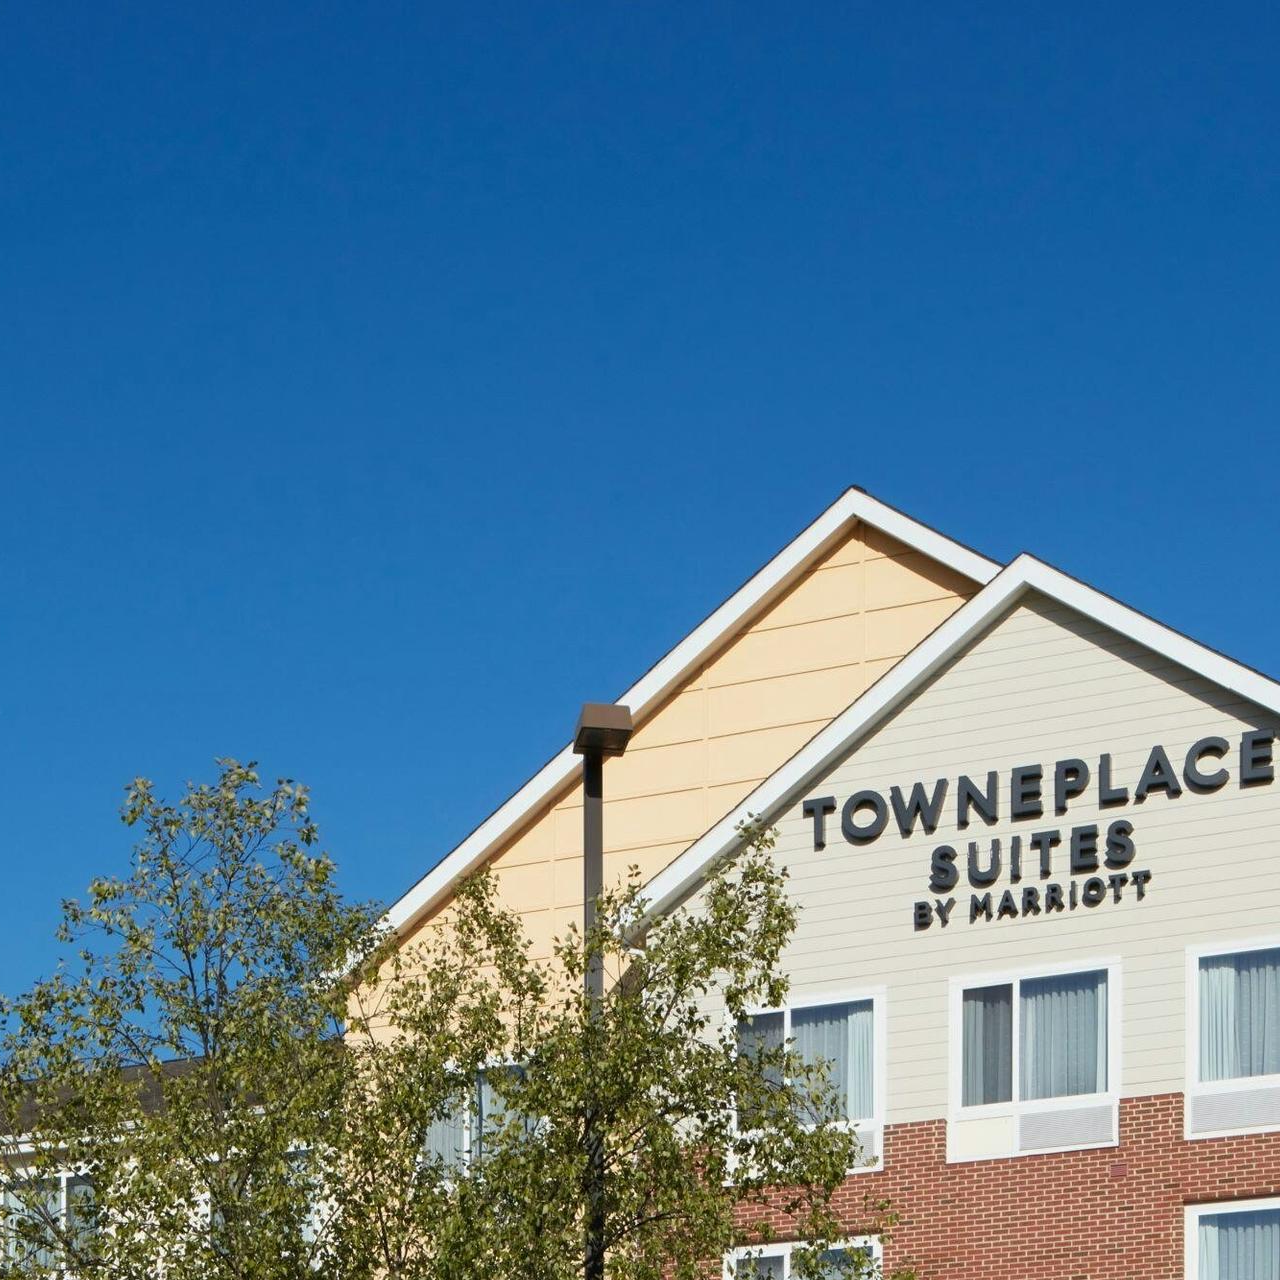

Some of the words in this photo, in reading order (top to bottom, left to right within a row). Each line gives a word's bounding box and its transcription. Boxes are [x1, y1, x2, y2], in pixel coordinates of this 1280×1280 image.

[803, 728, 1274, 852] TOWNEPLACE
[929, 820, 1136, 893] SUITES
[913, 896, 956, 931] BY
[969, 869, 1151, 925] MARRIOTT
